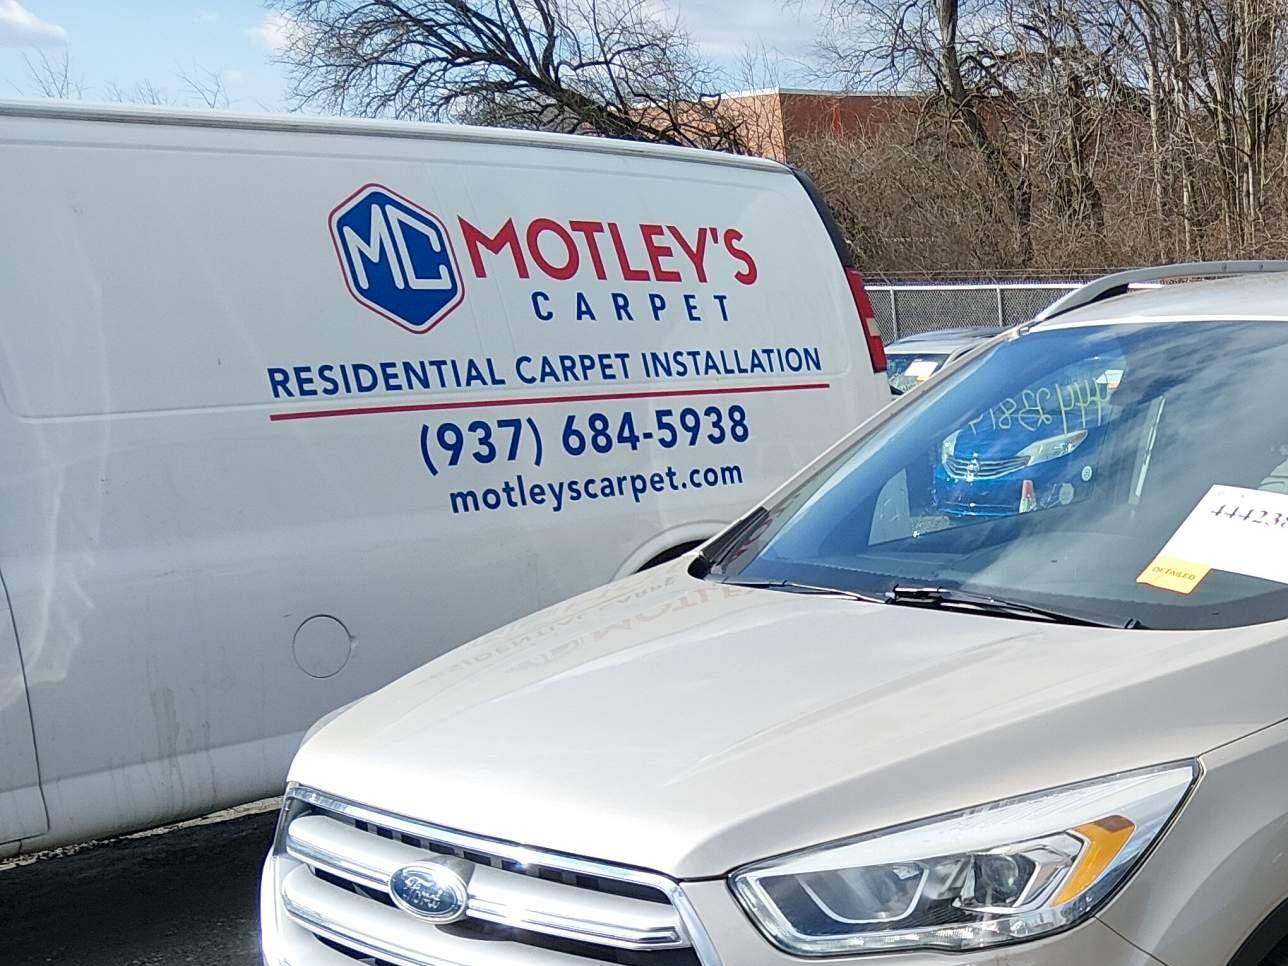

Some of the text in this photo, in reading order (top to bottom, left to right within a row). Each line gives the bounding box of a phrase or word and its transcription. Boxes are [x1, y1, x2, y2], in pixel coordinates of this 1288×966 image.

[343, 203, 453, 290] MC
[457, 214, 758, 285] MOTLEY'S
[531, 290, 730, 322] CARPET
[267, 347, 822, 398] RESIDENTIAL CARPET INSTALLATION
[419, 404, 749, 476] (937) 684-5938
[449, 463, 743, 514] motleyscarpet.com
[1151, 565, 1197, 582] DETAILED
